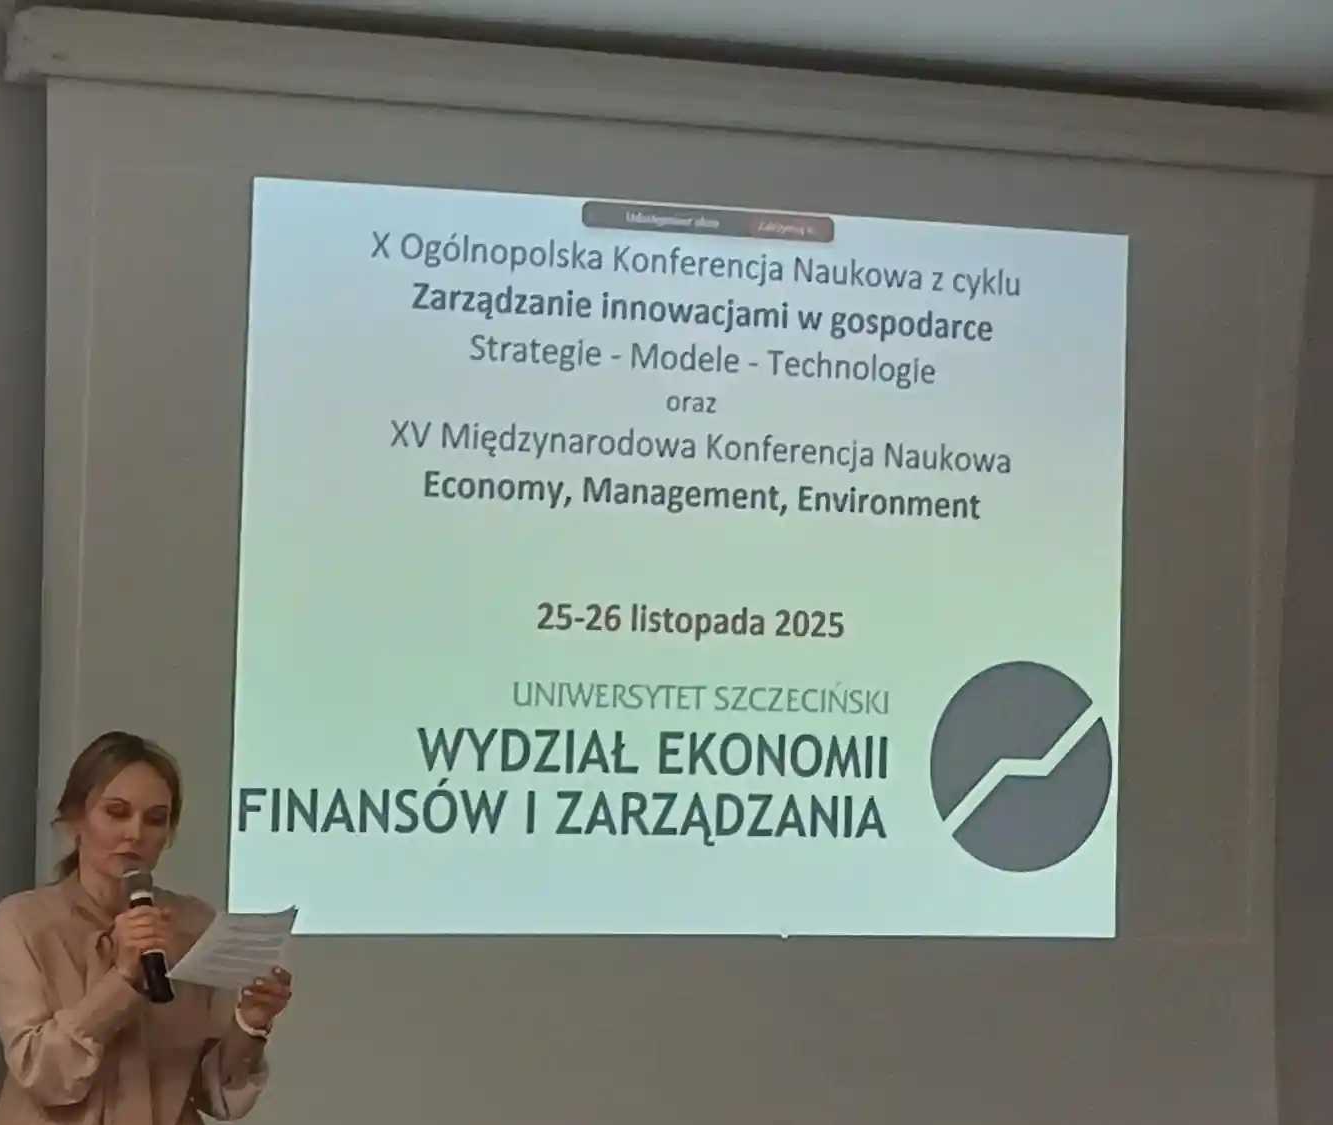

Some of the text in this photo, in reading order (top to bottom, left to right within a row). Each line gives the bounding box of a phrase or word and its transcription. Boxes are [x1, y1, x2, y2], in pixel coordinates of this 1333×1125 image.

[371, 231, 1022, 300] X Ogólnopolska Konferencja Naukowa z cyklu
[412, 284, 994, 345] Zarządzanie innowacjami w gospodarce
[470, 335, 602, 372] Strategie
[630, 344, 740, 376] Modele
[767, 350, 937, 387] Technologie
[666, 392, 717, 415] oraz
[389, 420, 1013, 474] XV Międzynarodowa Konferencja Naukowa
[423, 471, 981, 522] Economy, Management, Environment
[536, 602, 845, 642] 25-26 listopada 2025
[512, 680, 890, 716] UNIWERSYTET SZCZECIŃSKI
[417, 726, 890, 780] WYDZIAŁ EKONOMII
[237, 779, 887, 848] FINANSÓW I ZARZĄDZANIA
